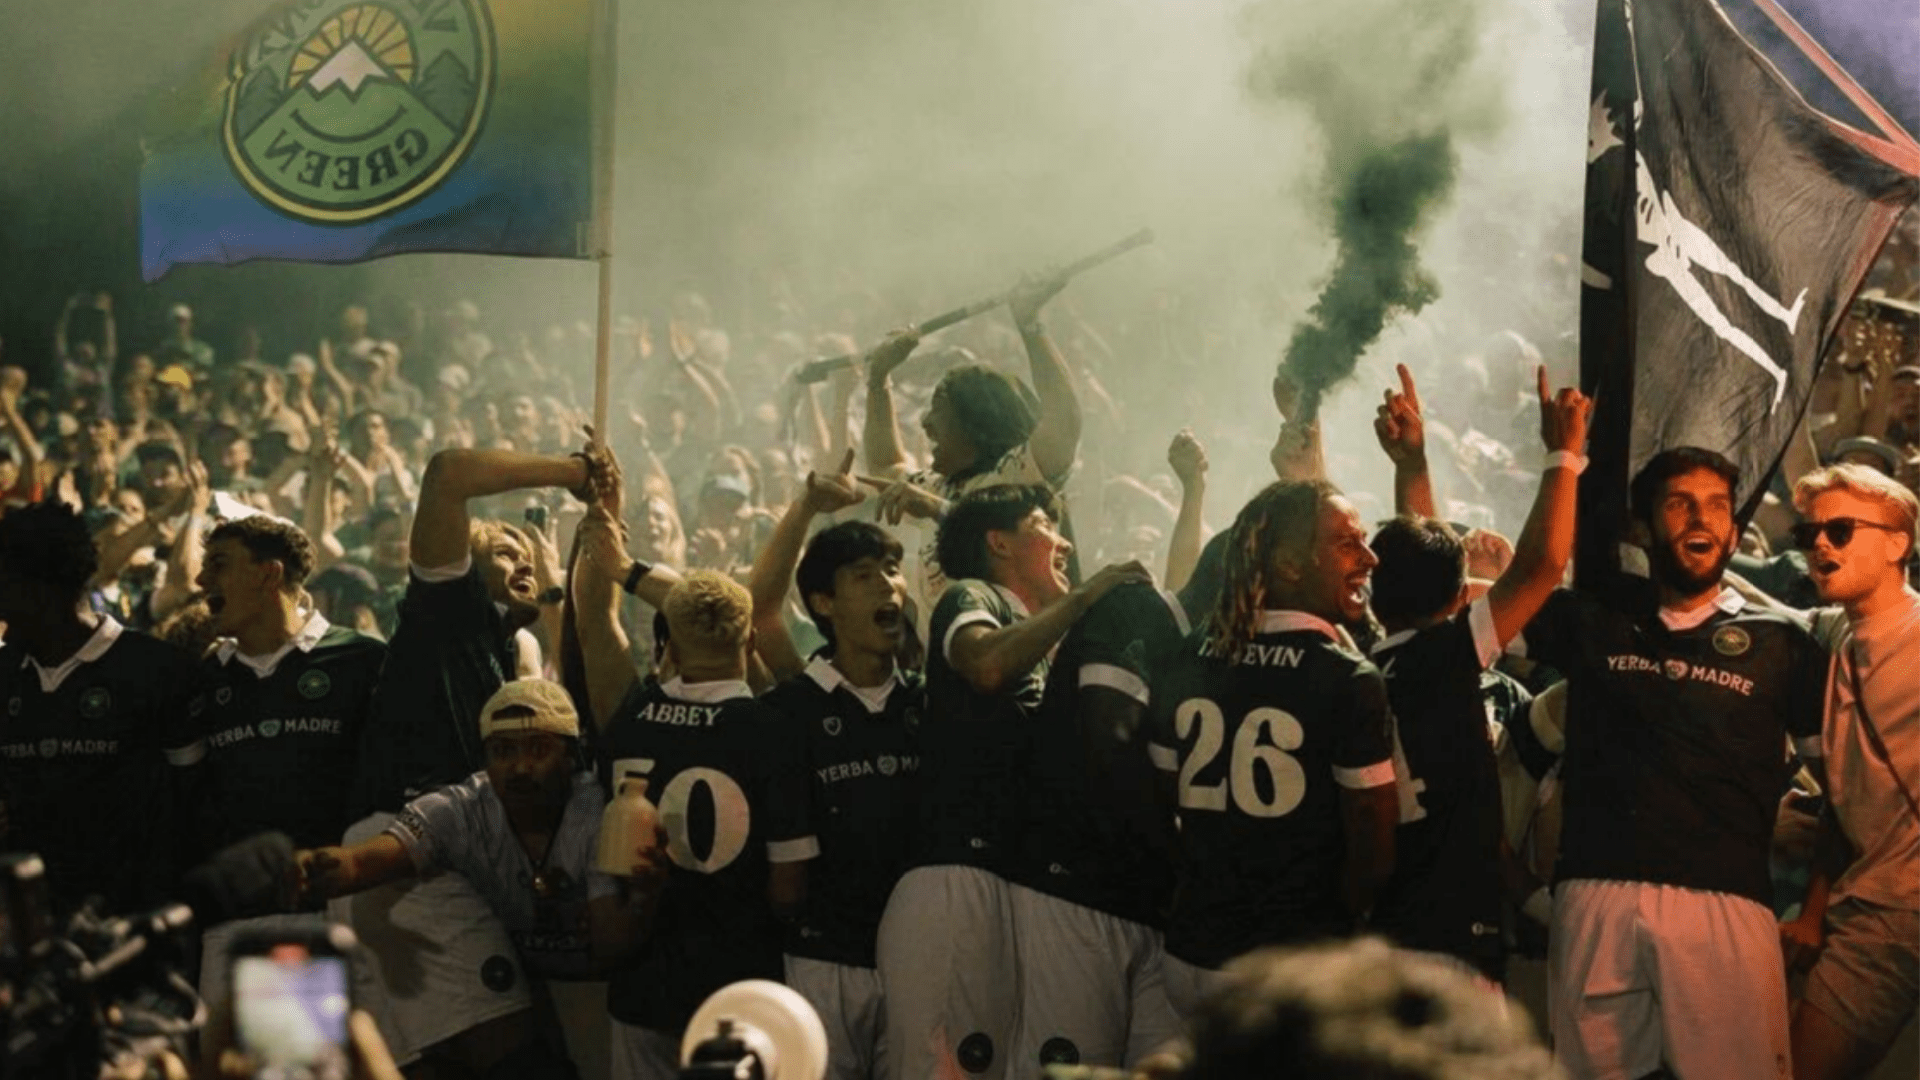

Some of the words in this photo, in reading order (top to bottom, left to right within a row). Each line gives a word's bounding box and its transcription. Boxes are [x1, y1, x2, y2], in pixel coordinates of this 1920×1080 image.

[1607, 655, 1661, 674] YERBA
[1691, 665, 1754, 696] MADRE
[637, 702, 723, 726] ABBEY
[208, 724, 255, 748] YERBA
[284, 717, 342, 734] MADRE
[816, 759, 874, 783] YERBA
[1175, 698, 1306, 818] 26
